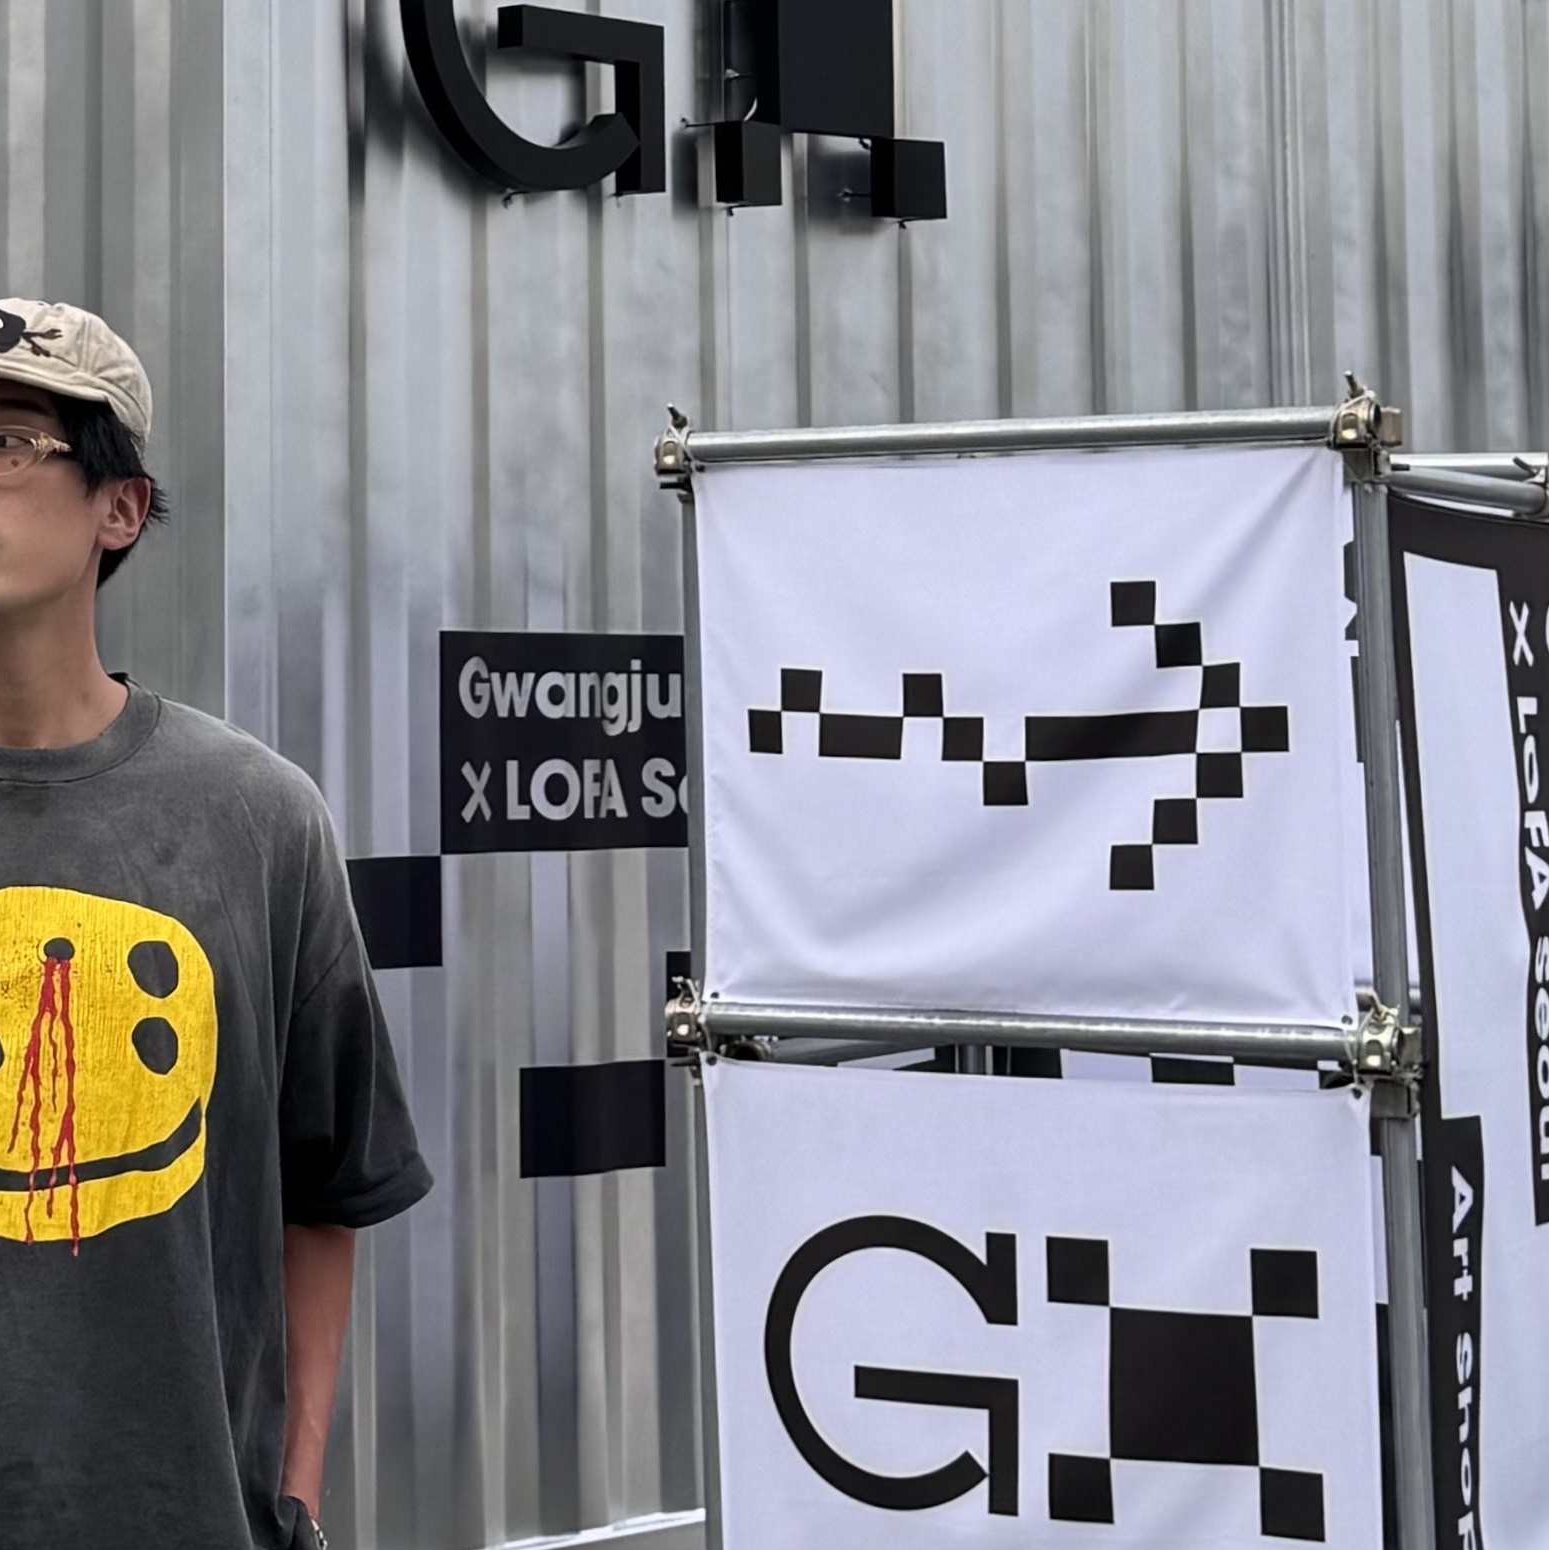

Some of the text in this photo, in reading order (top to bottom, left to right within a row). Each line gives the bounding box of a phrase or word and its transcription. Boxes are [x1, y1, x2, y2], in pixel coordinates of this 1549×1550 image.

[458, 656, 682, 736] Gwangju
[461, 757, 688, 823] X LOFA S
[1517, 696, 1549, 911] LOFA
[1451, 1165, 1474, 1301] Art
